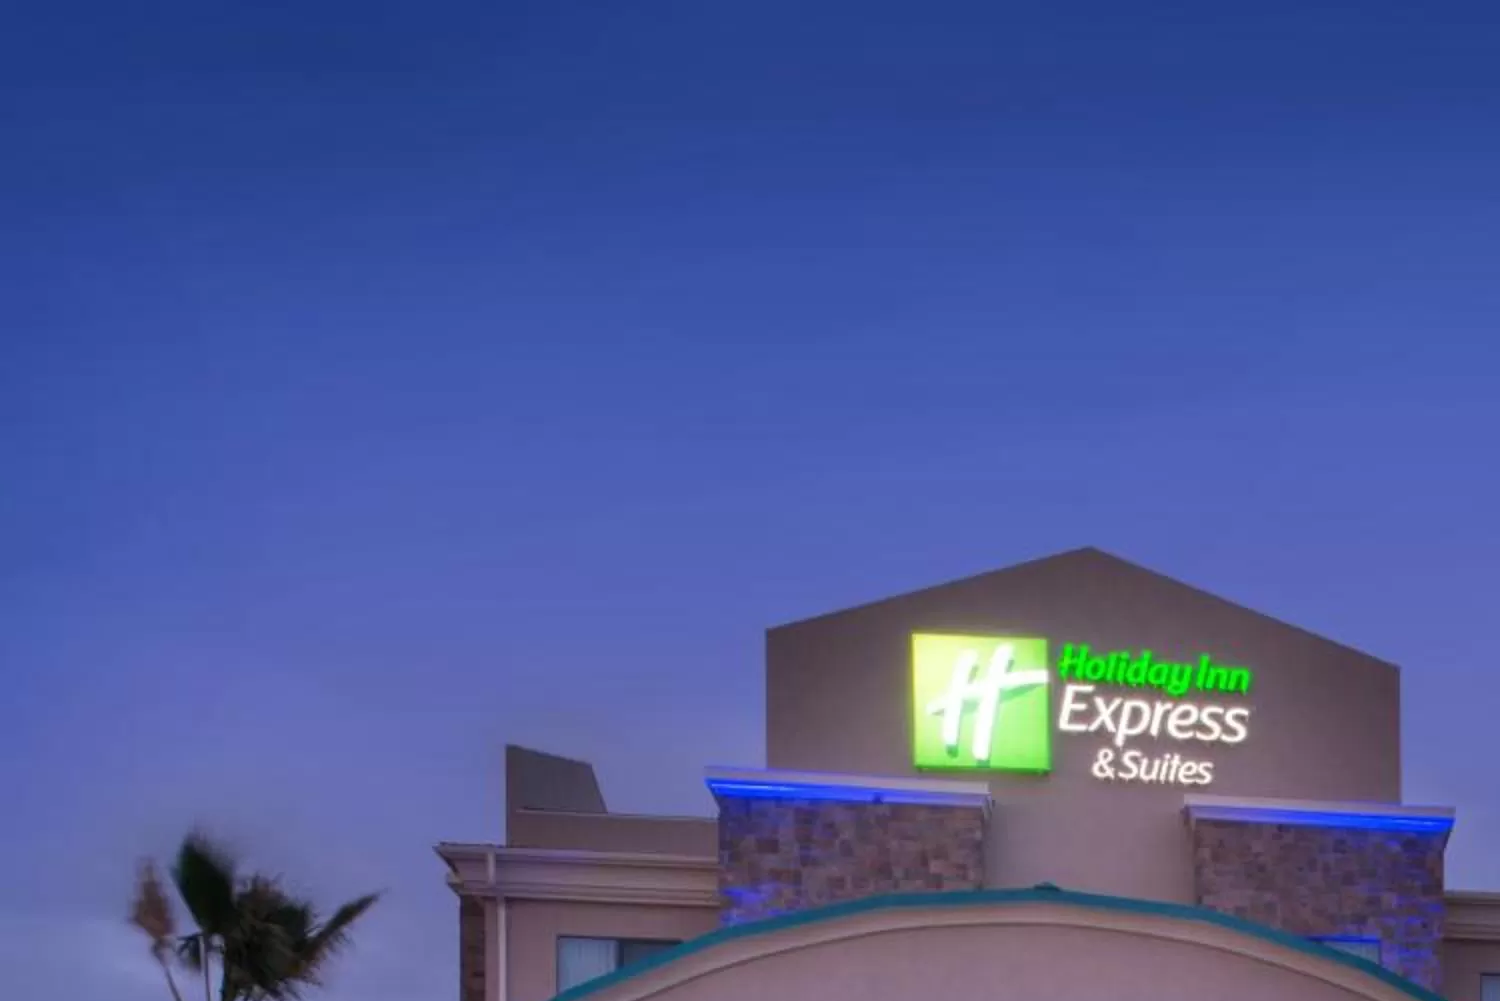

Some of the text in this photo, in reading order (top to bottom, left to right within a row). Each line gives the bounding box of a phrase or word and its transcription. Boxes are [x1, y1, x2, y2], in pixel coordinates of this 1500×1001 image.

[1057, 643, 1252, 696] Holiday Inn
[1057, 683, 1251, 747] Express
